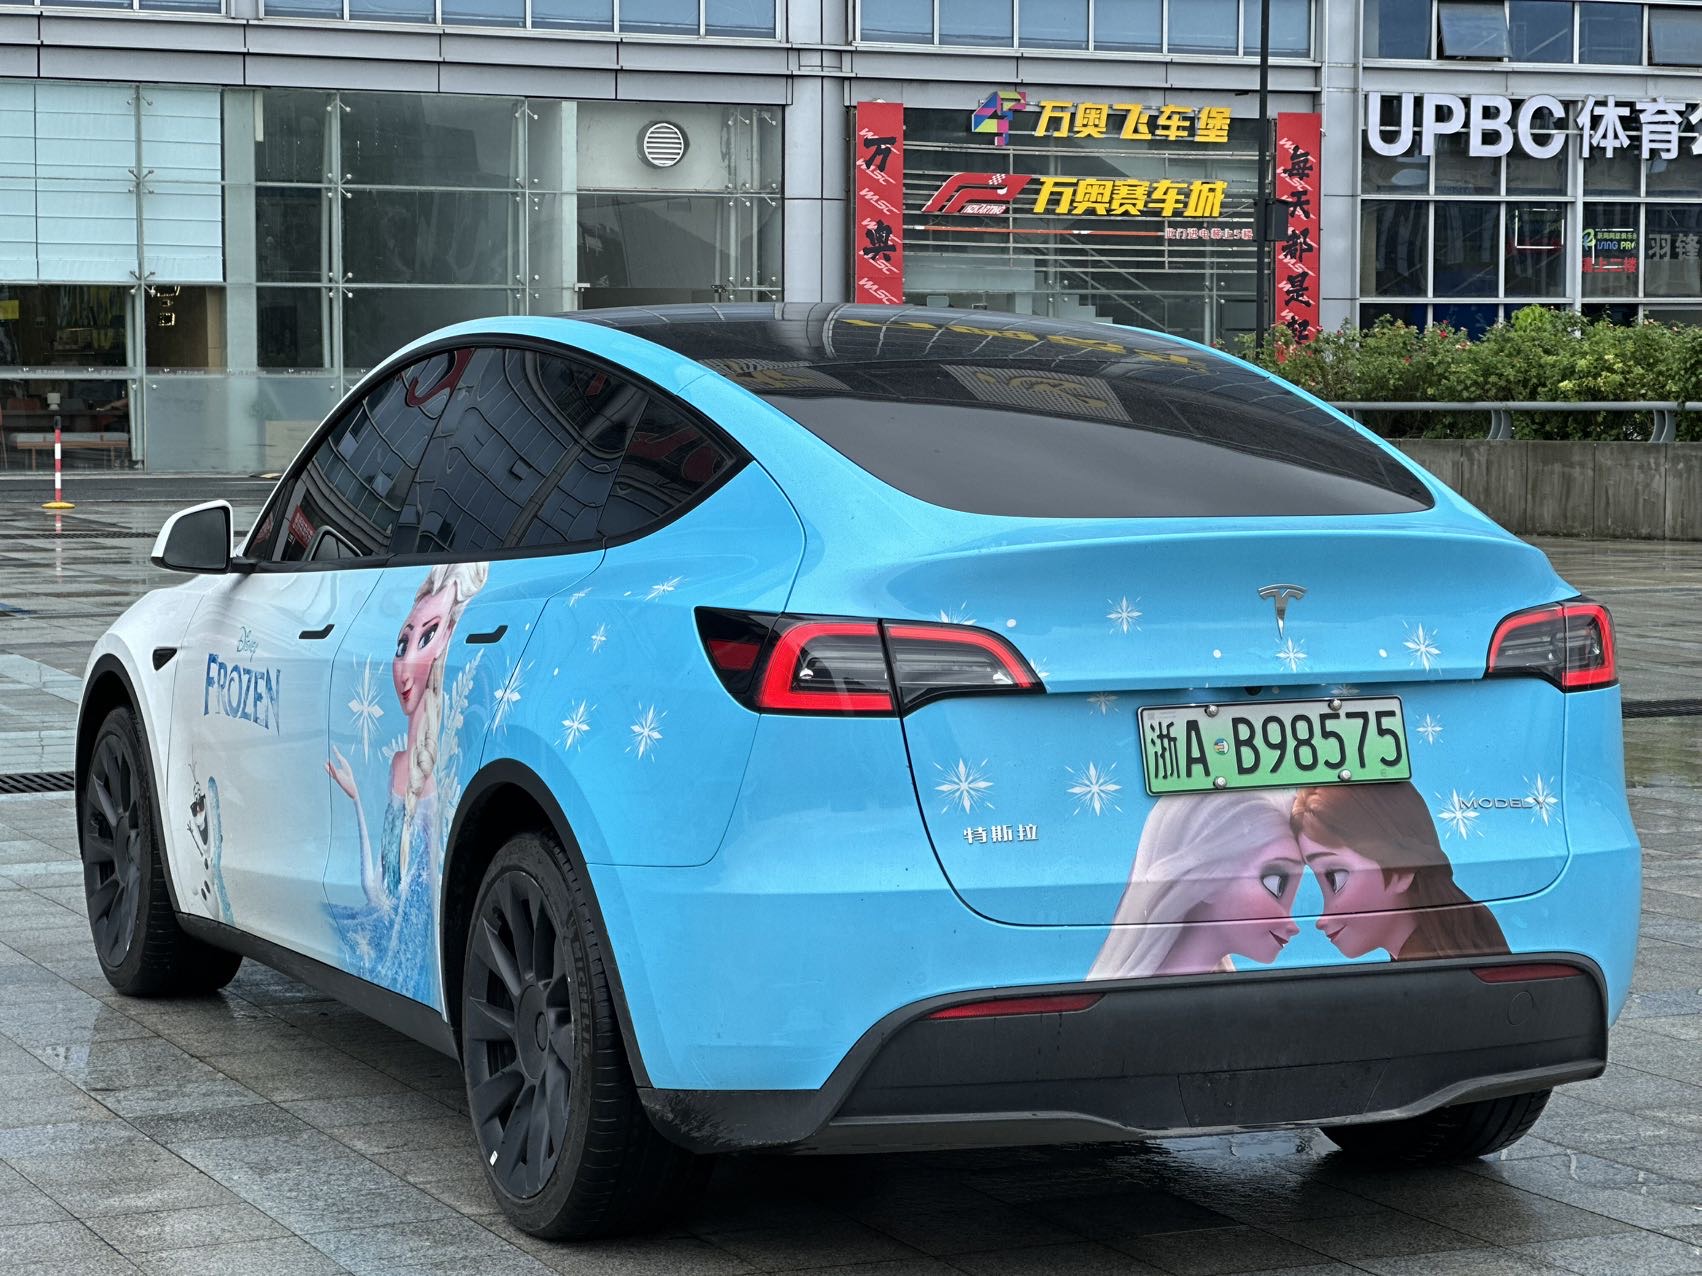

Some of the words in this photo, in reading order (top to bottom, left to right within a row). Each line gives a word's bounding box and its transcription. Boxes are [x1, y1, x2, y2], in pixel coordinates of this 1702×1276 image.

[1034, 101, 1232, 142] 万奥飞车堡
[1367, 92, 1566, 159] UPBC
[1033, 177, 1227, 217] 万奥赛车城
[203, 653, 281, 736] FROZEN
[1150, 720, 1211, 779] 浙A
[1231, 711, 1402, 774] B98575
[1459, 797, 1532, 809] MODEL
[963, 823, 1039, 844] 特斯拉
